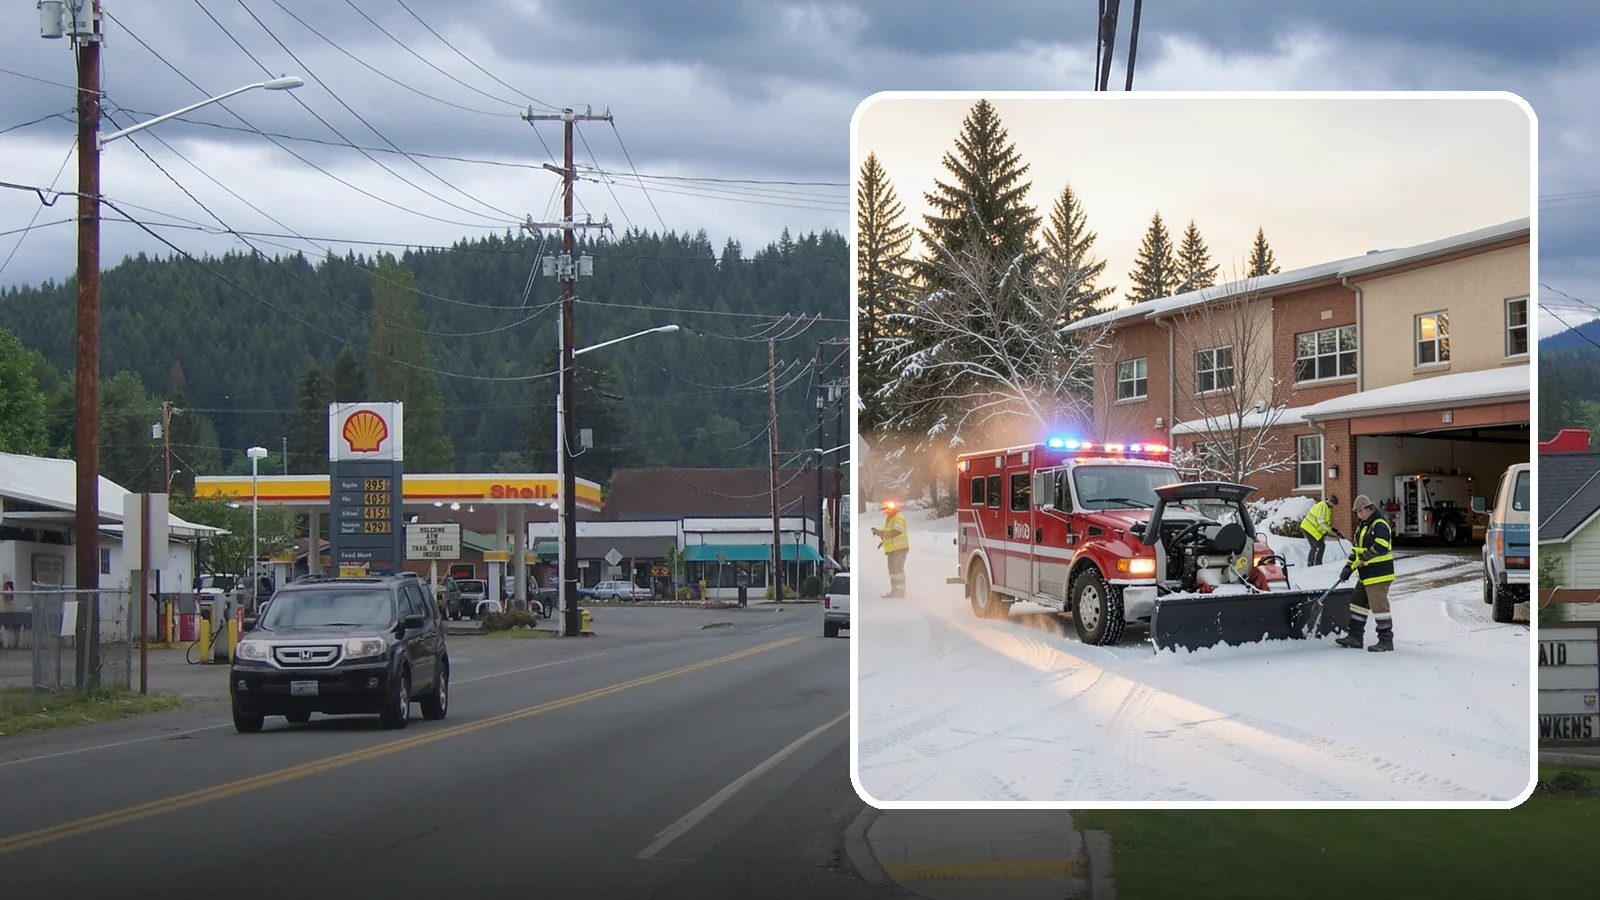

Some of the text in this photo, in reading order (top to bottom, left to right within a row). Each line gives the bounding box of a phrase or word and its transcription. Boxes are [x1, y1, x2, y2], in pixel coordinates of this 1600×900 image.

[366, 480, 383, 490] 395
[490, 484, 547, 499] Shell
[366, 494, 383, 504] 405
[366, 508, 383, 518] 415
[366, 522, 383, 532] 429
